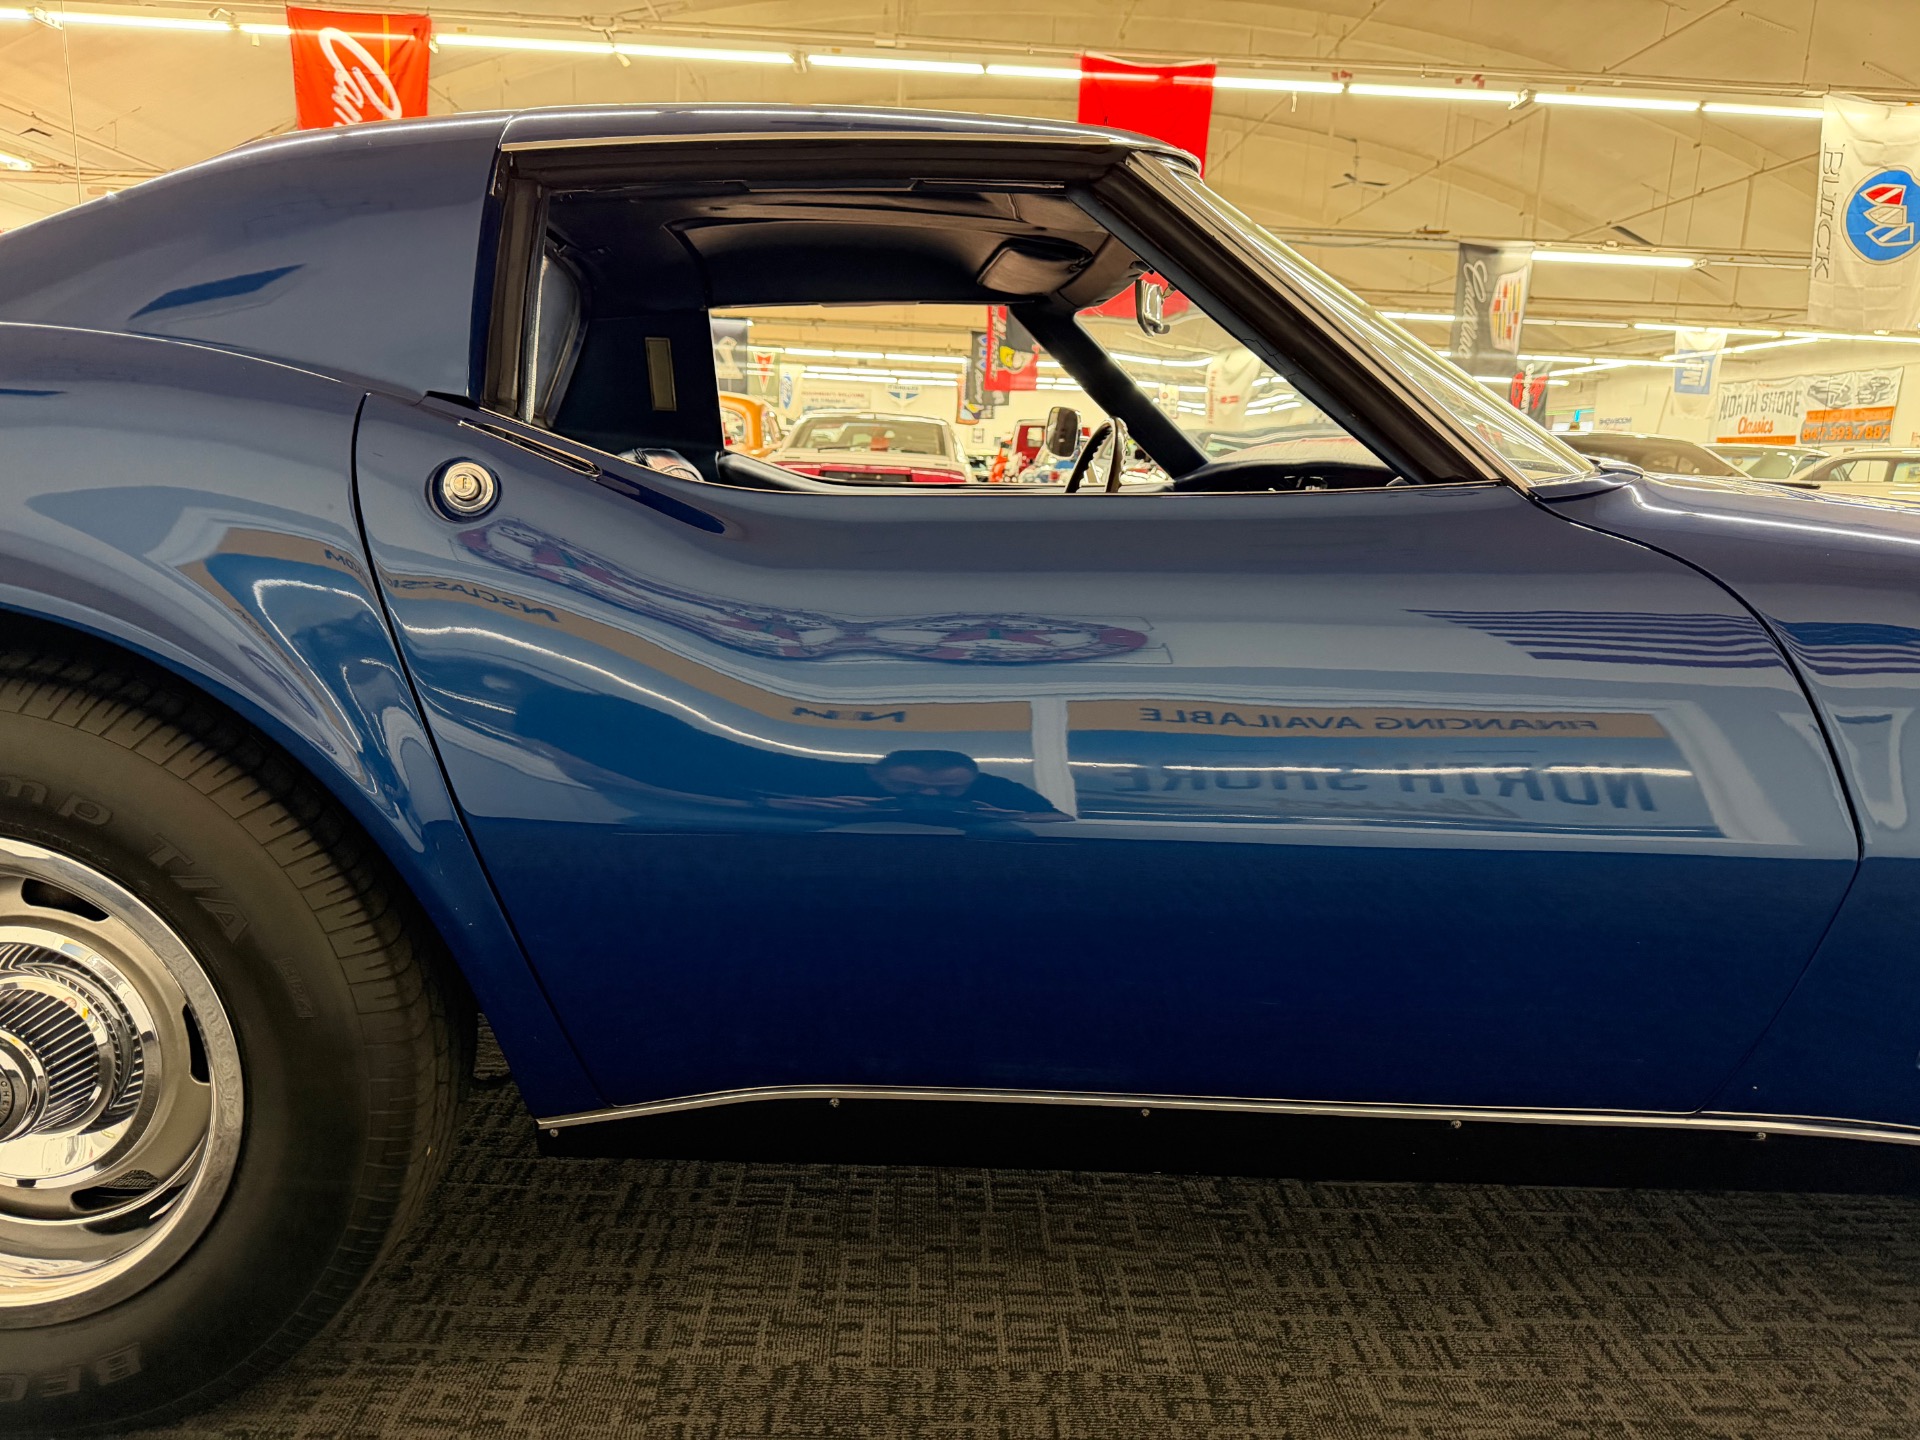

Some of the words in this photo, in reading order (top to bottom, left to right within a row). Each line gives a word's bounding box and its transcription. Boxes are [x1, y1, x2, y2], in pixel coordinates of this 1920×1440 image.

[1813, 143, 1845, 279] BUICK
[1458, 260, 1488, 360] Cadillac
[1717, 394, 1758, 421] NORTH
[1760, 390, 1802, 417] SHORE
[1737, 416, 1774, 435] Classics
